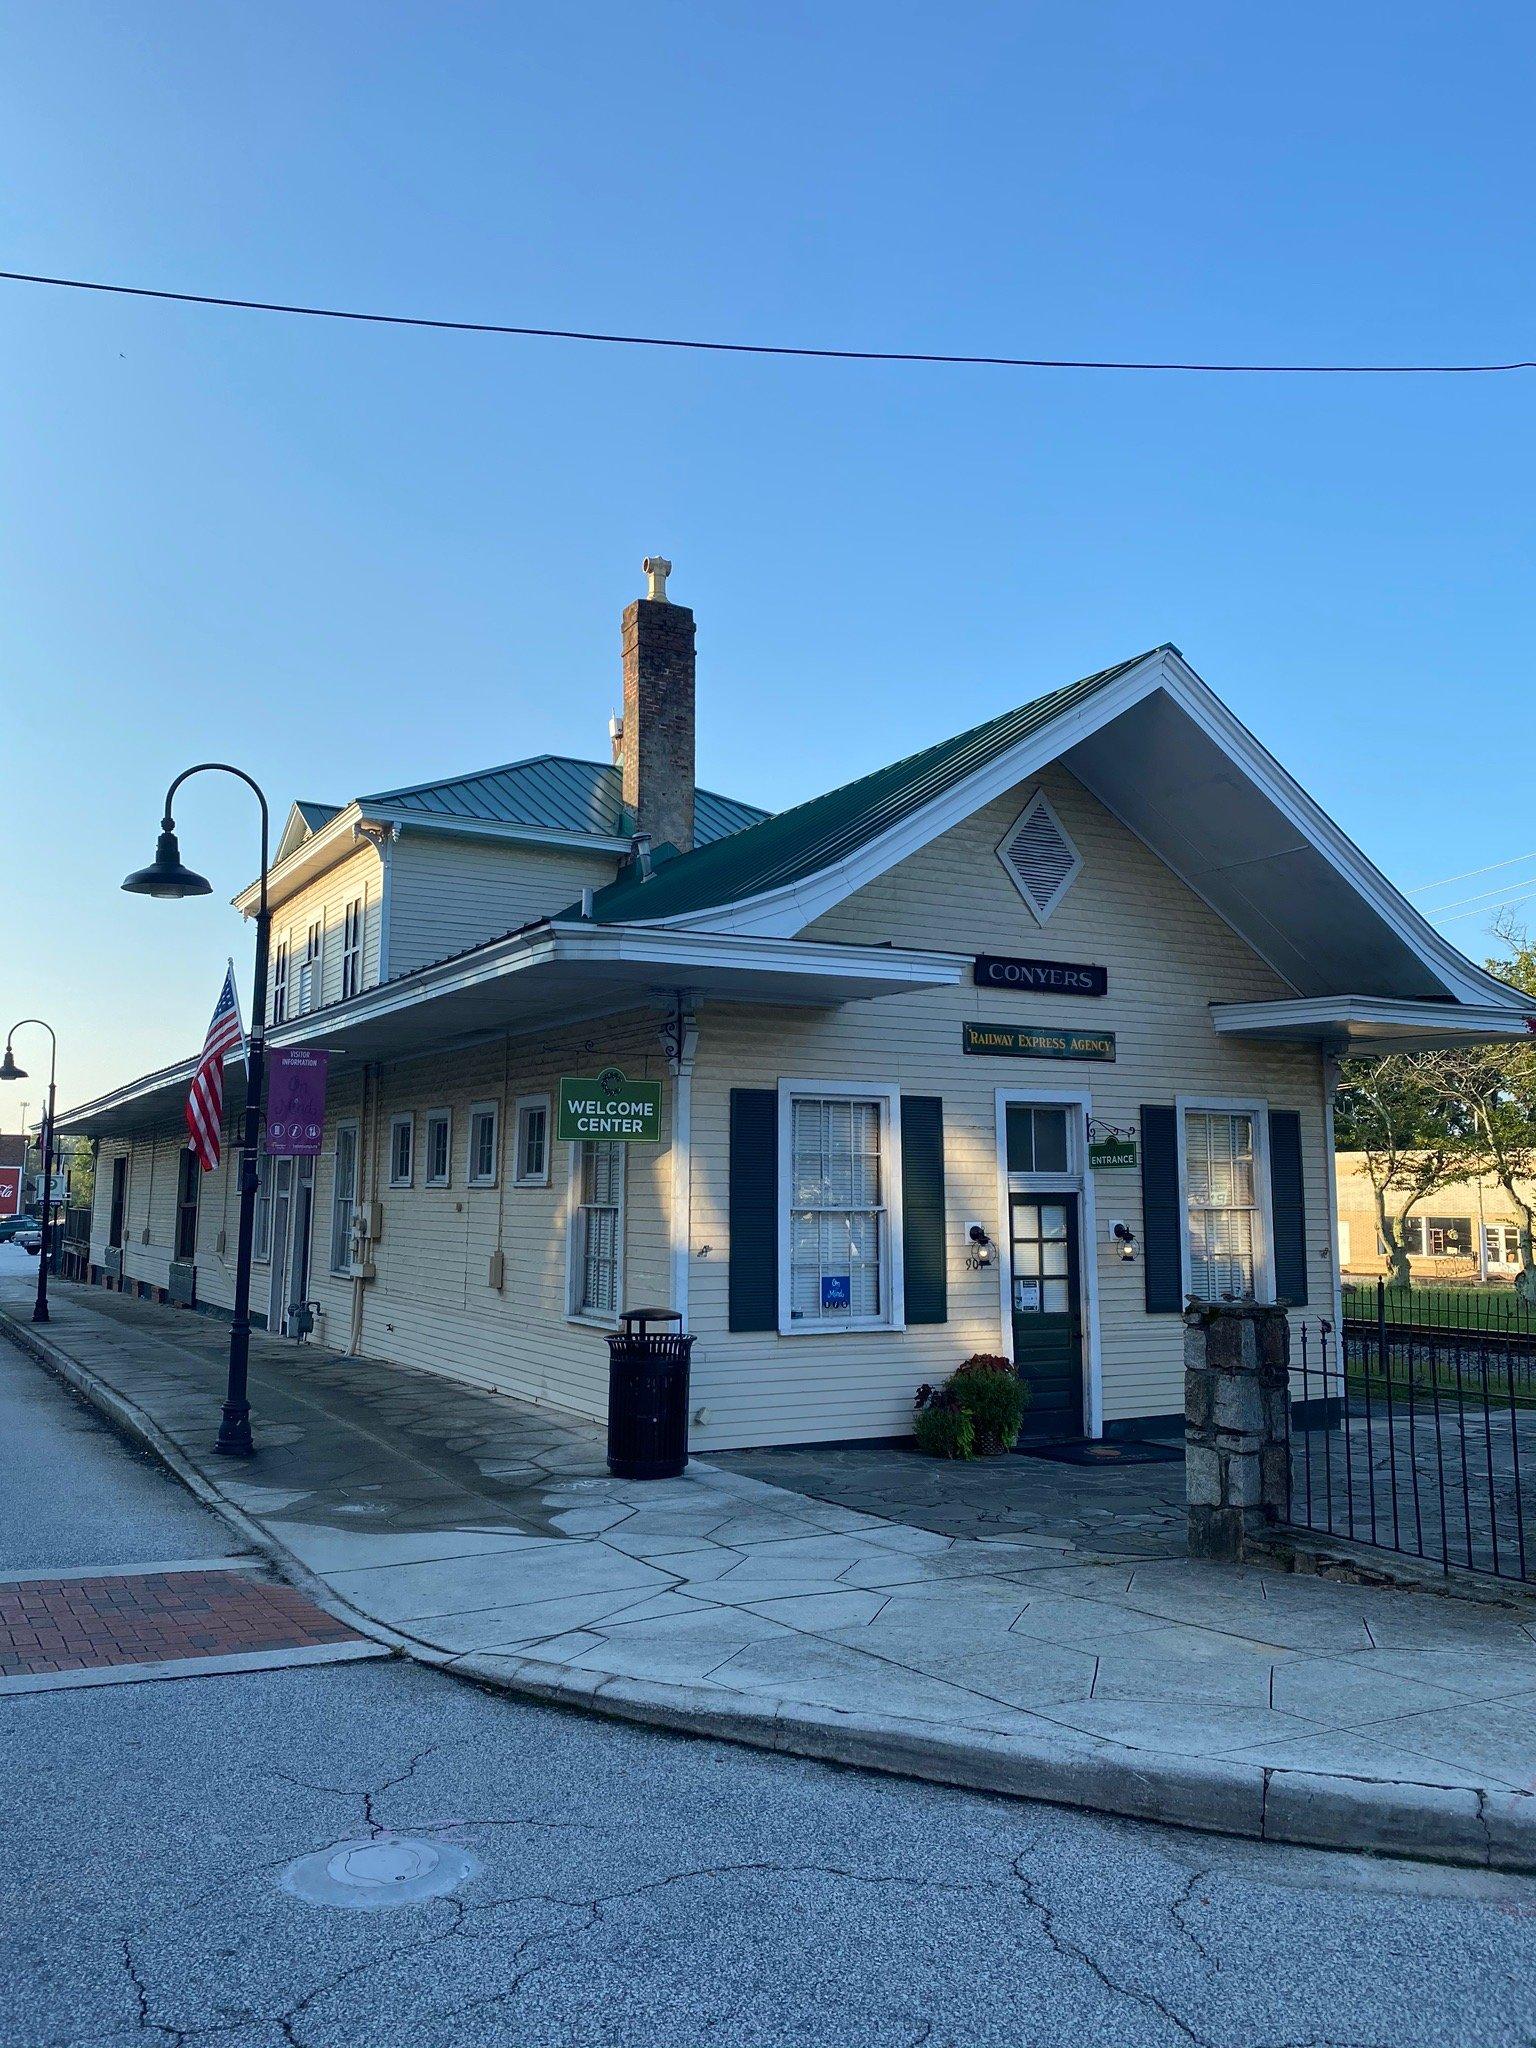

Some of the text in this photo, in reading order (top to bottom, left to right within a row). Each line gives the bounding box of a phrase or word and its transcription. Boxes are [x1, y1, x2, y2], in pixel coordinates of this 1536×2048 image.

[989, 963, 1093, 988] CONYERS
[970, 1031, 1112, 1052] RAILWAY EXPRESS AGENCY
[281, 1059, 318, 1067] INFORMATION
[568, 1100, 654, 1117] WELCOME
[577, 1118, 643, 1133] CENTER
[1091, 1155, 1134, 1165] ENTRANCE
